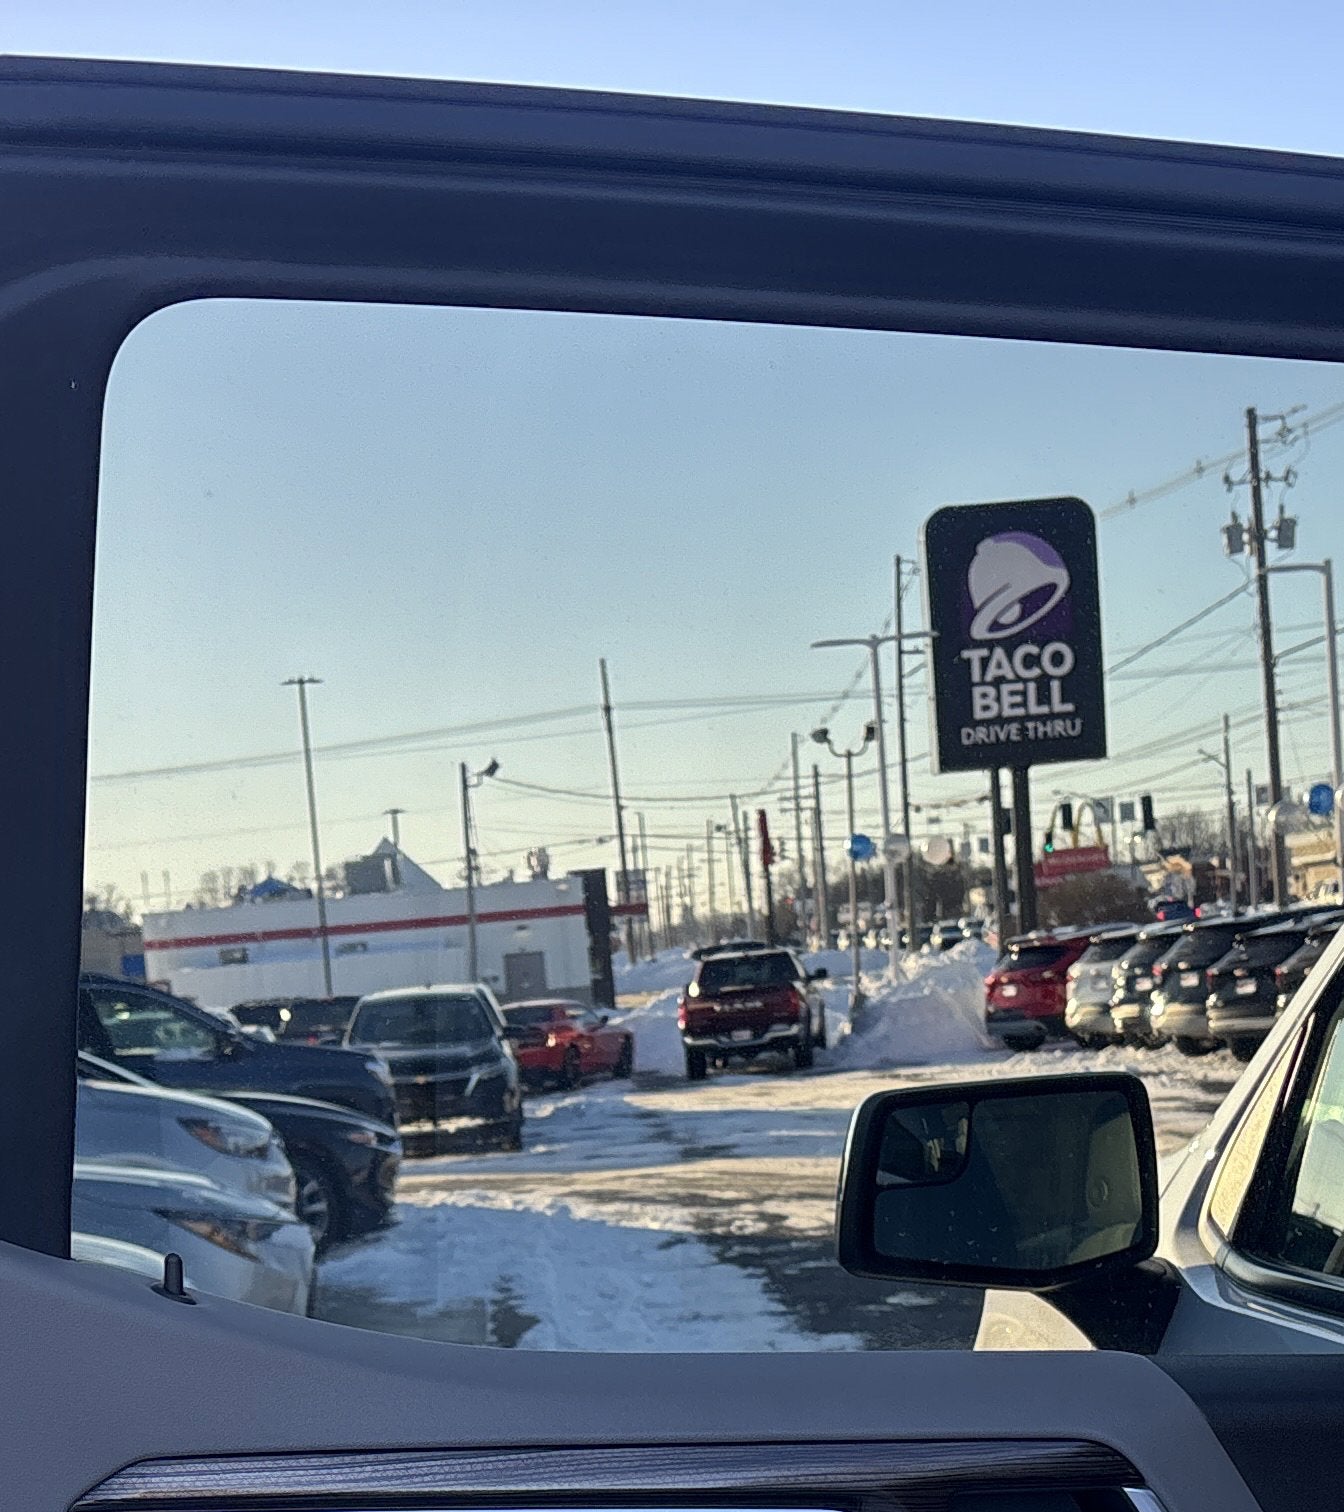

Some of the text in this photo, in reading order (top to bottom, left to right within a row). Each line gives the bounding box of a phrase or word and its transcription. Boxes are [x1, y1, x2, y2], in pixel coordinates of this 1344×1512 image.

[961, 641, 1075, 682] TACO
[972, 680, 1075, 720] BELL
[960, 719, 1083, 745] DRIVE THRU
